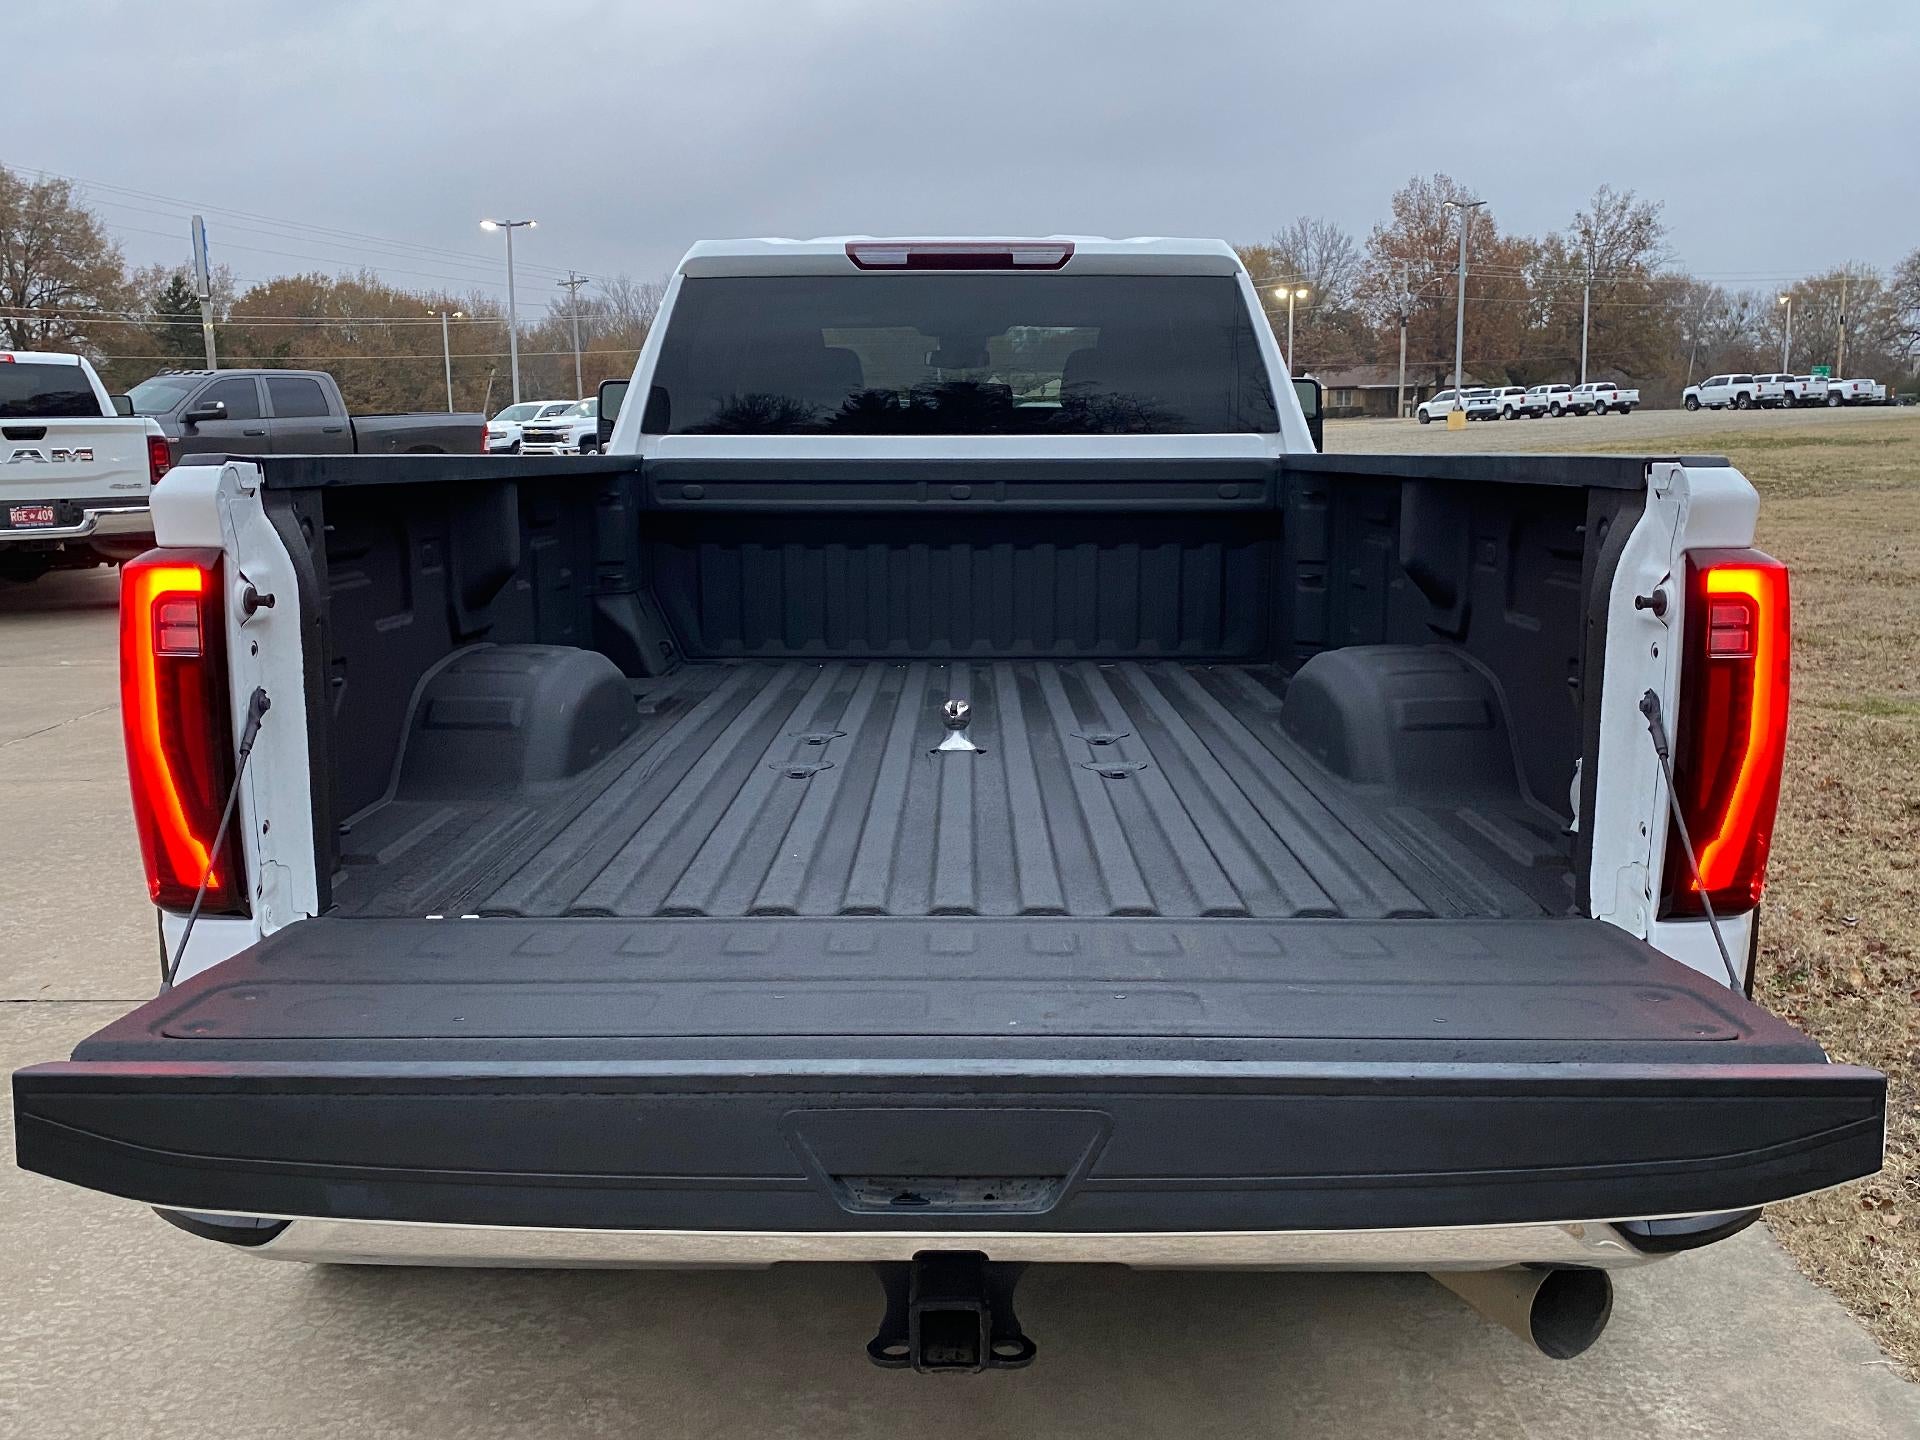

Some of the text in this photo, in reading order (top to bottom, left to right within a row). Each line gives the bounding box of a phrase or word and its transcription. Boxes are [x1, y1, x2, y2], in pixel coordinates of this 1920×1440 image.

[0, 447, 94, 464] AM
[10, 510, 54, 521] RGE 409
